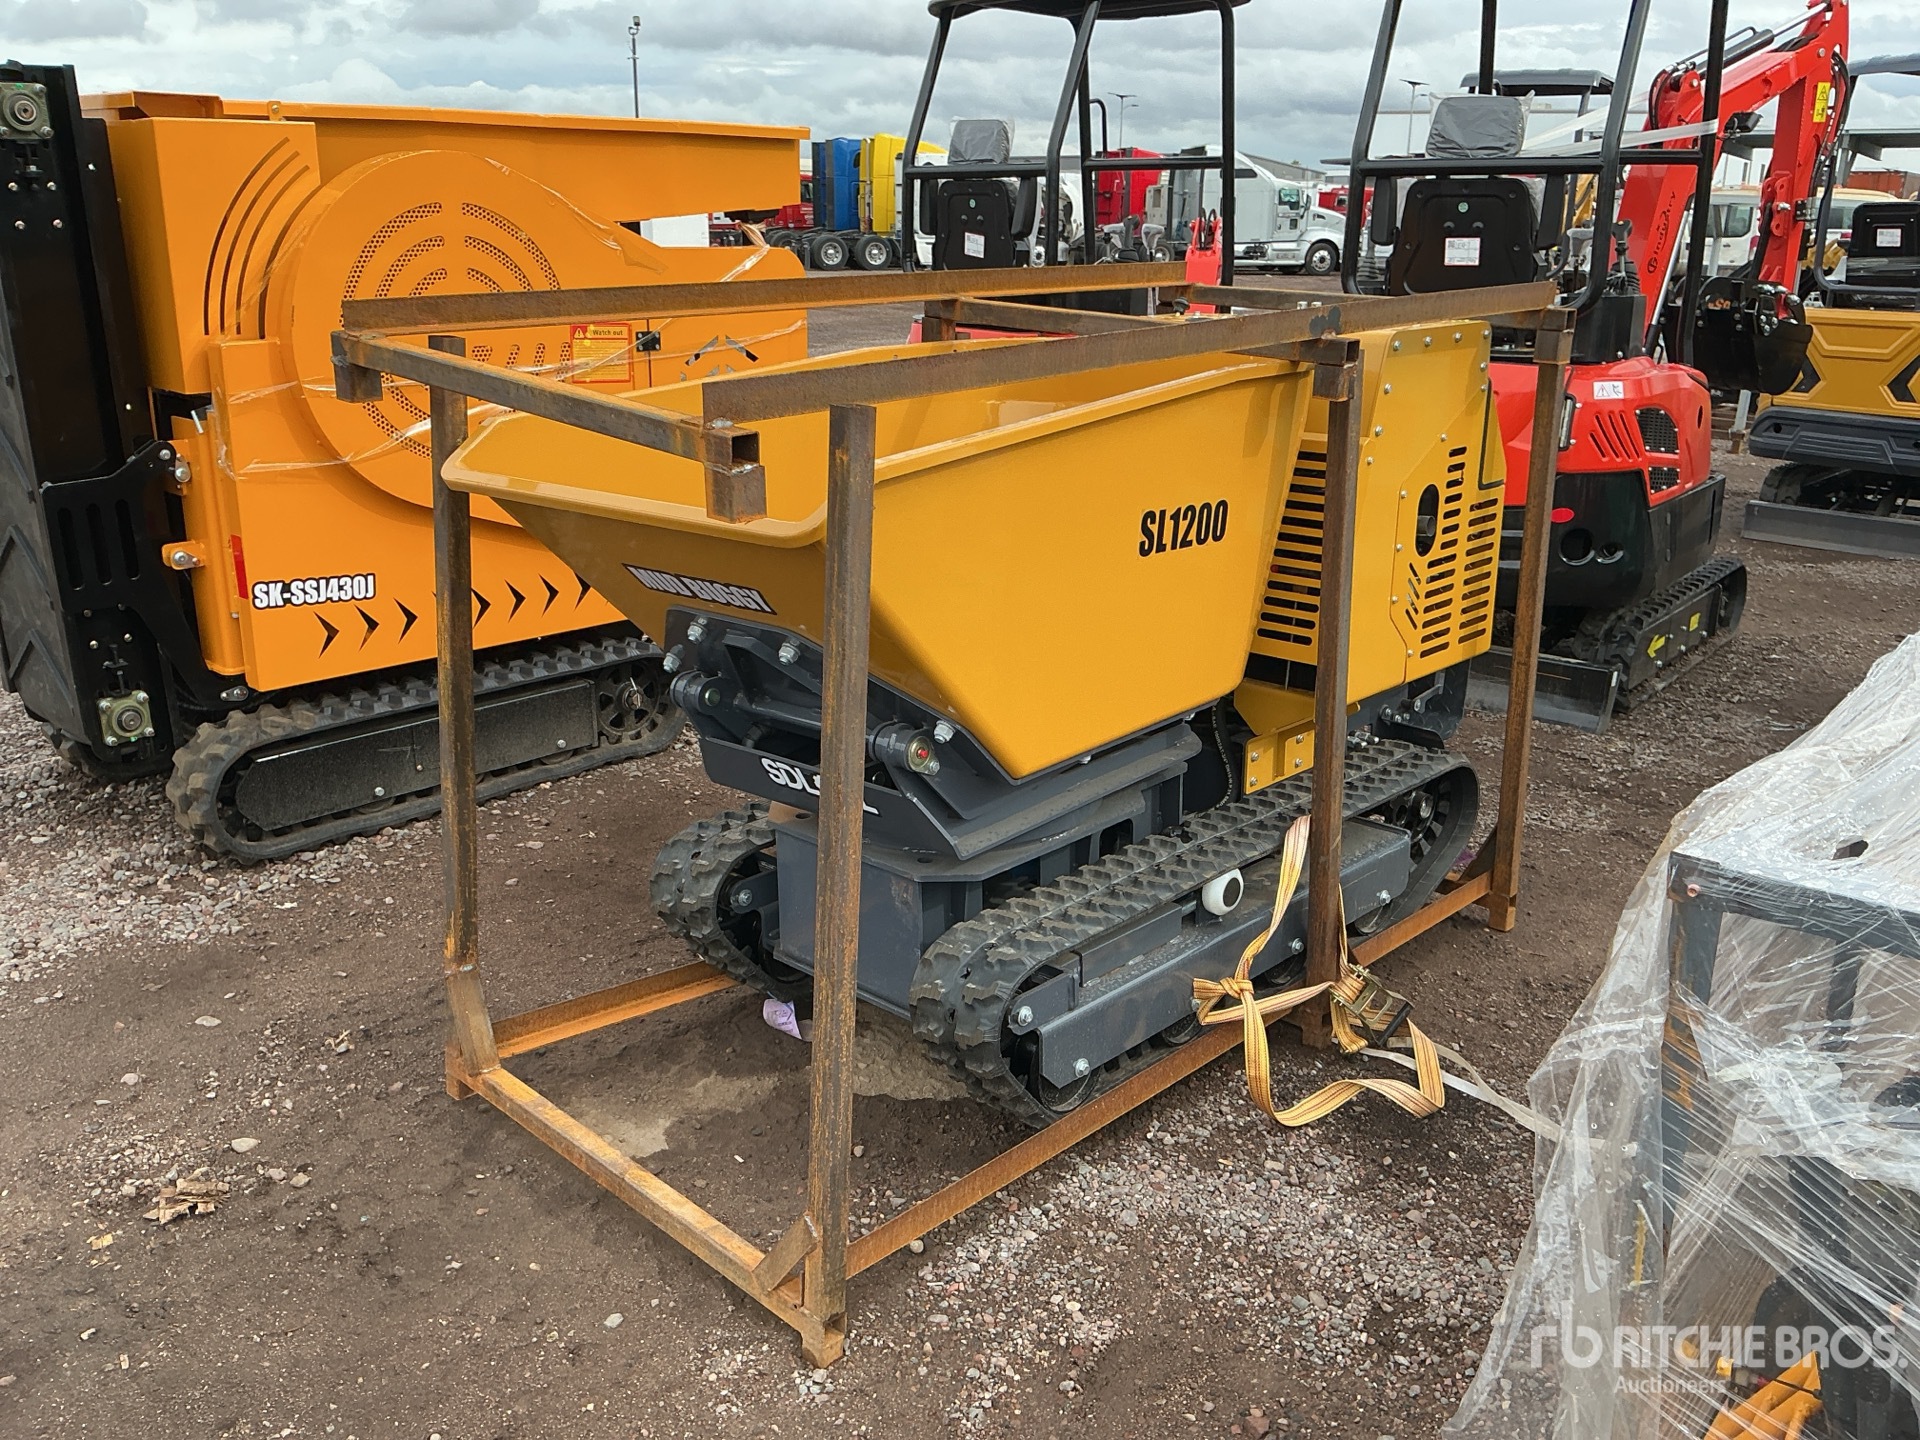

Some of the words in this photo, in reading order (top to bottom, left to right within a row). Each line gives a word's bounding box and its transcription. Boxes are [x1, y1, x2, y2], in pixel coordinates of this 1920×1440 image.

[1138, 499, 1229, 557] SL1200
[252, 573, 376, 609] SK-SSJ430J
[623, 564, 696, 598] MUD
[677, 574, 776, 614] BUGGY
